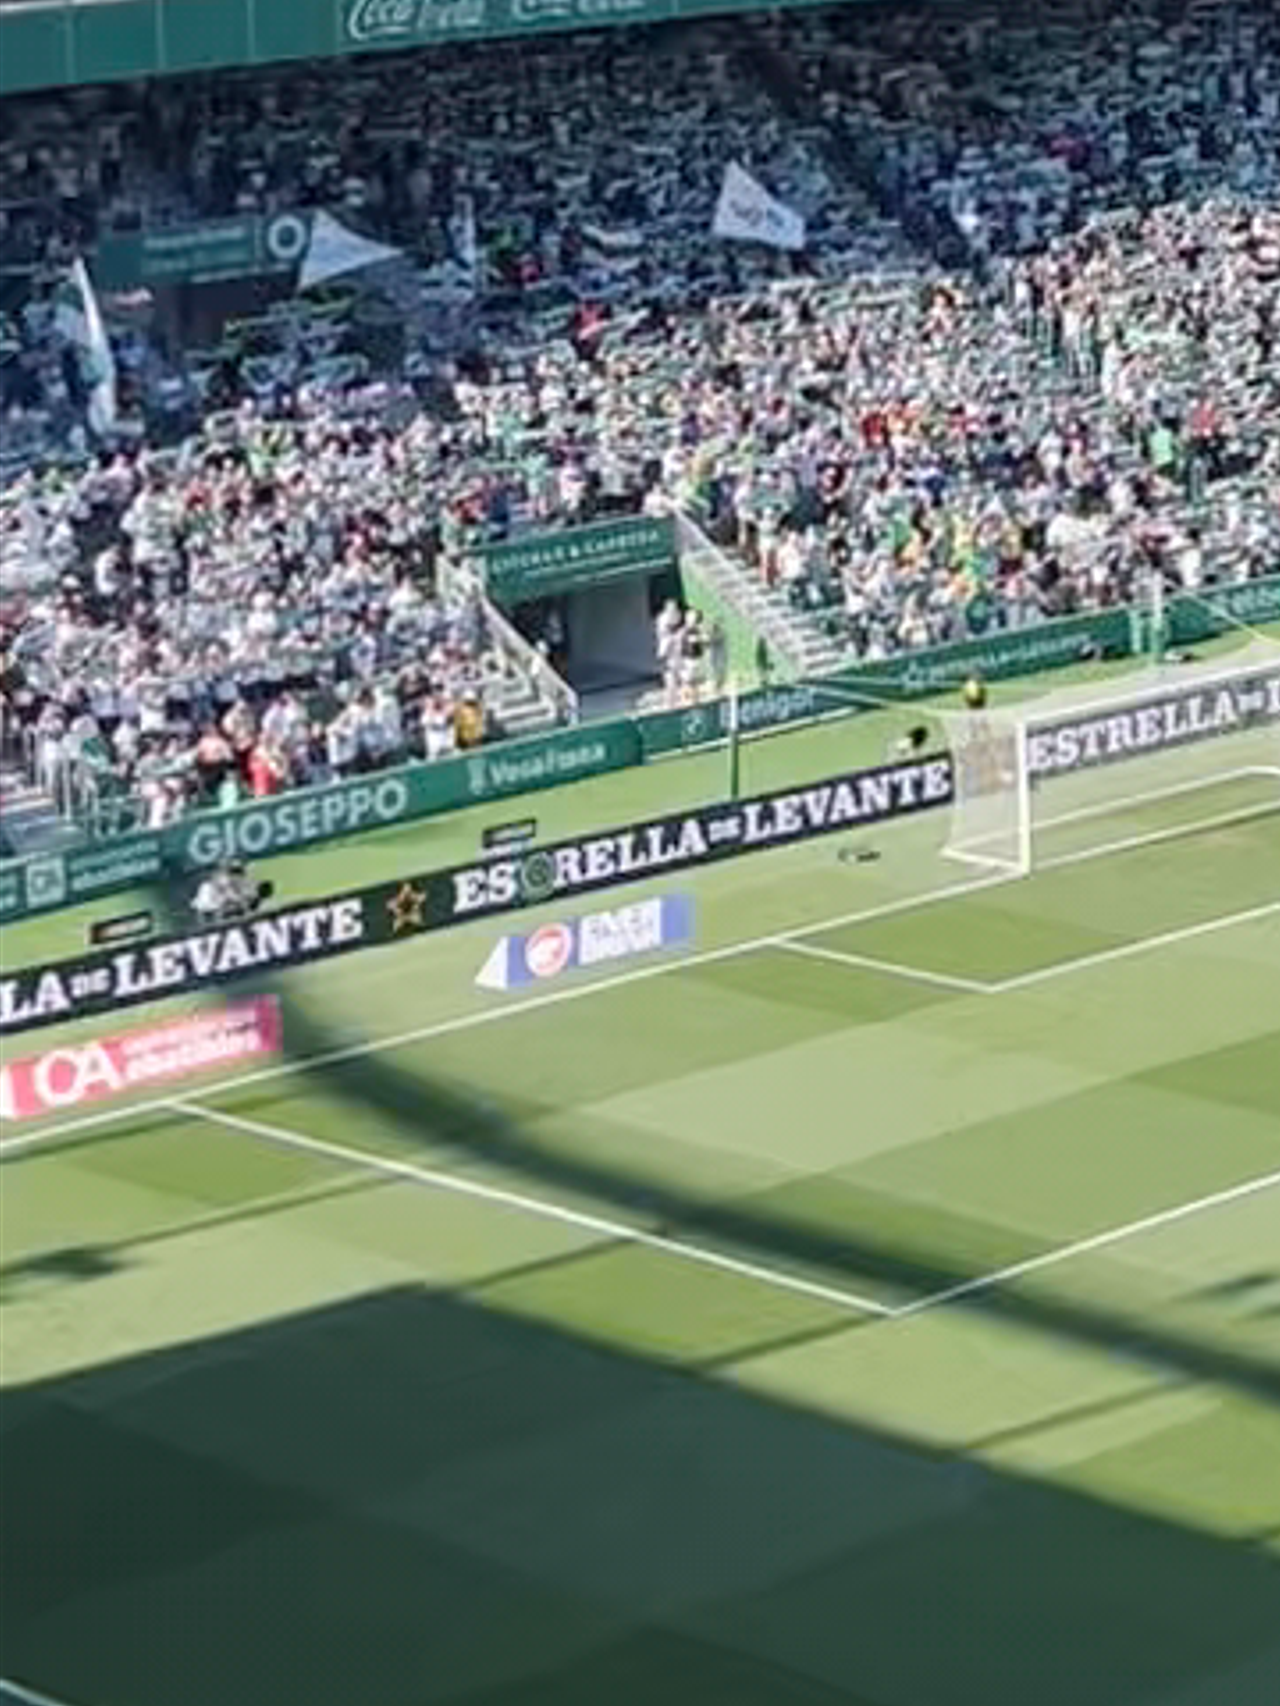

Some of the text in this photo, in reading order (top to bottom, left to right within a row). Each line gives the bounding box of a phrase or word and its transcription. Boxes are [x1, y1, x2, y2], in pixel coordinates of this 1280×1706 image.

[1026, 692, 1238, 774] ESTRELLA
[188, 779, 408, 865] GIOSEPPO
[453, 817, 708, 914] ESRELLA
[741, 760, 952, 838] LEVANTE
[112, 898, 364, 999] LEVANTE
